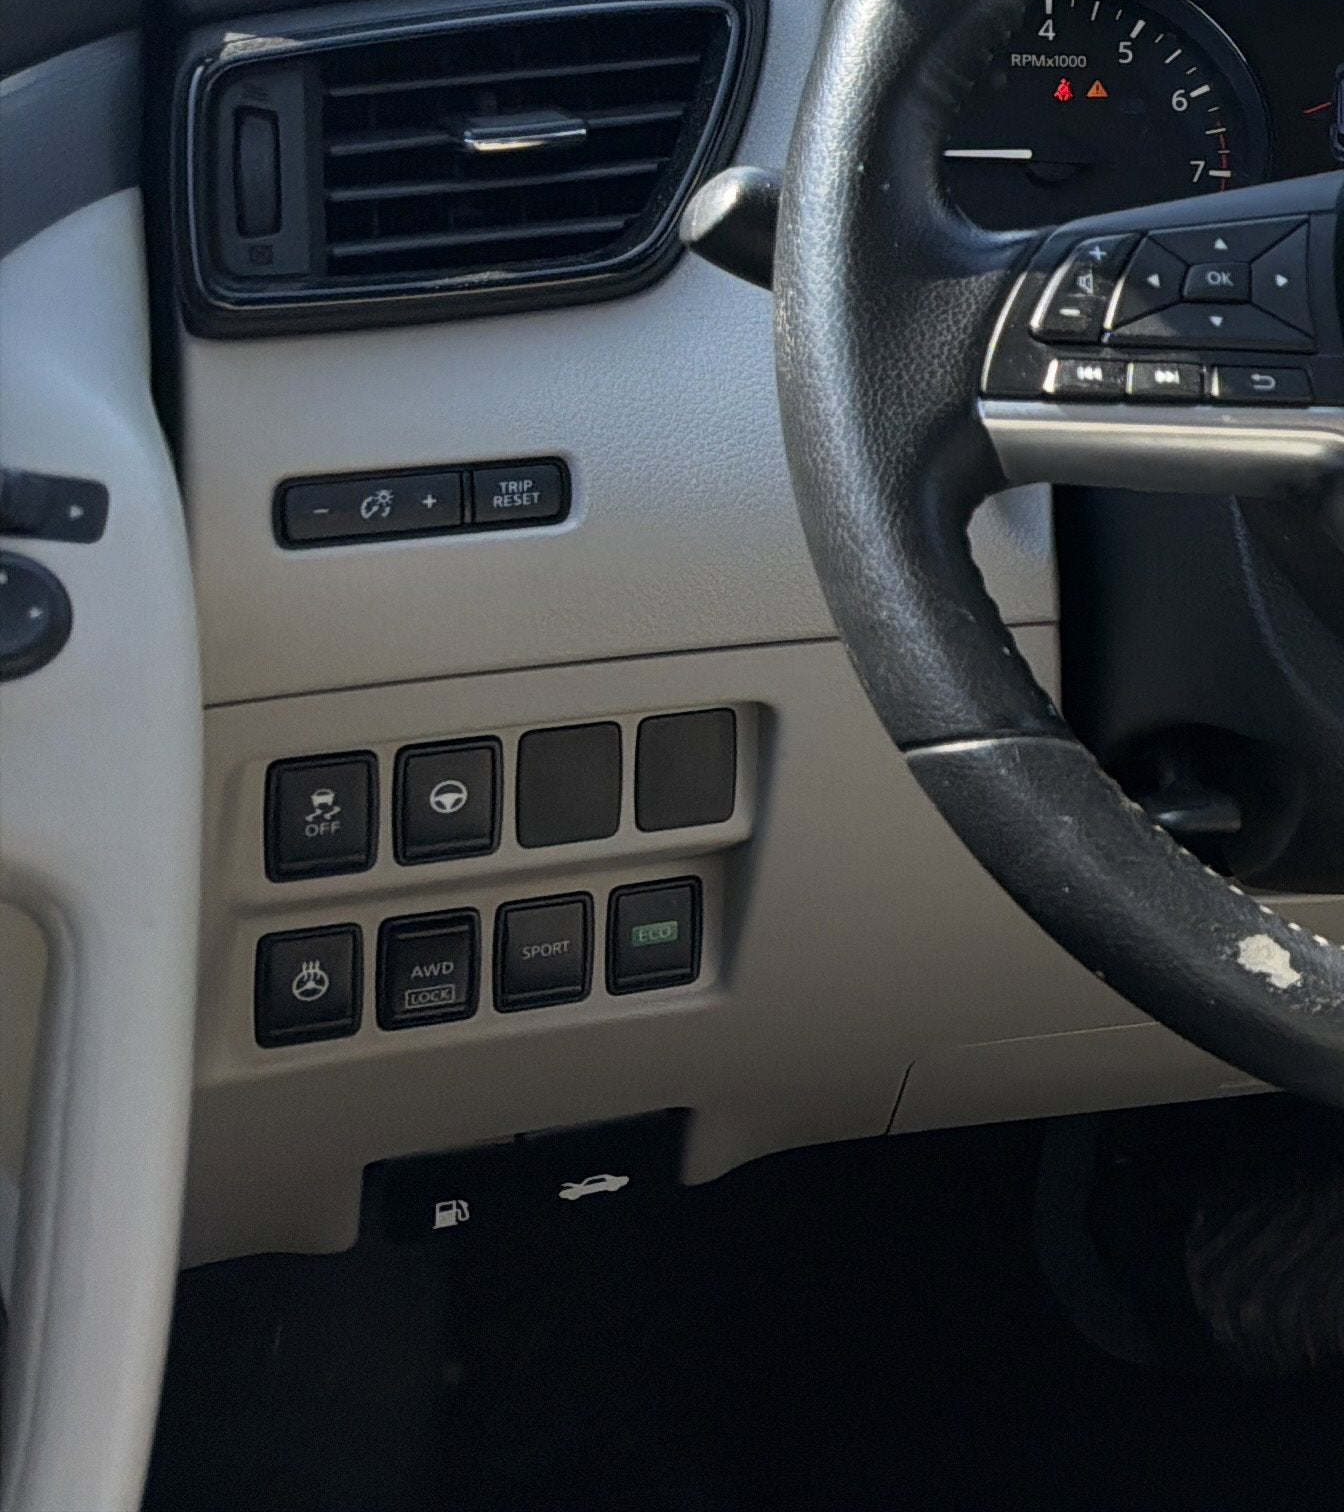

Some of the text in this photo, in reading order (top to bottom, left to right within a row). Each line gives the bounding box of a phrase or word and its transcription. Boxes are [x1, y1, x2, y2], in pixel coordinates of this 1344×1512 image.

[1038, 19, 1056, 41] 4
[1011, 53, 1087, 68] RPMx1000
[1118, 41, 1134, 64] 5
[1171, 89, 1188, 112] 6
[1189, 160, 1206, 183] 7
[1205, 270, 1234, 288] OK
[499, 479, 534, 495] TRIP
[493, 491, 540, 509] RESET
[304, 820, 342, 838] OFF
[637, 925, 673, 943] ECO
[522, 940, 571, 960] SPORT
[410, 960, 455, 979] AWD
[409, 988, 451, 1005] LOCK
